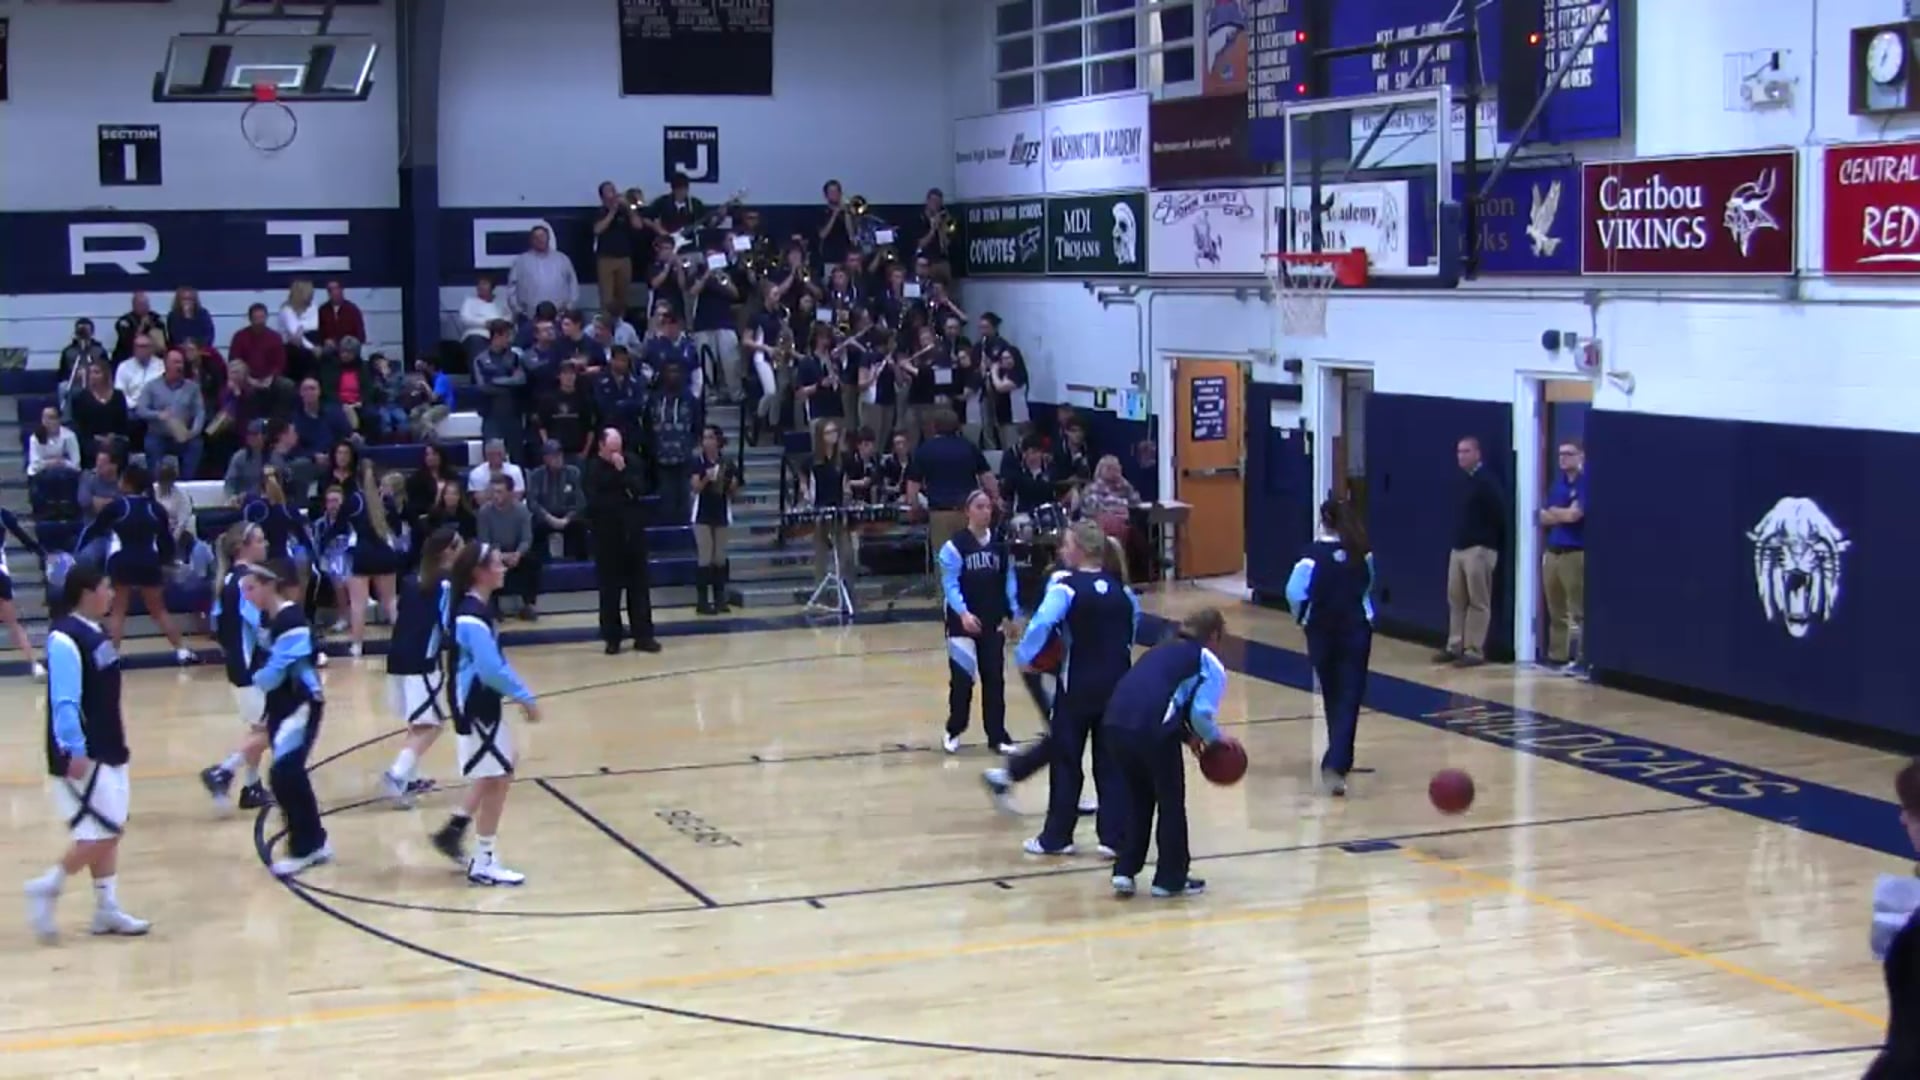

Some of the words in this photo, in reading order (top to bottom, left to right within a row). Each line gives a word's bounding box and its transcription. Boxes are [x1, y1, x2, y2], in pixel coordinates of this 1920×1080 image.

[101, 129, 158, 140] SECTION
[667, 130, 717, 140] SECTION
[1051, 131, 1100, 163] WASHINGTON
[1103, 127, 1142, 158] ACADEMY
[675, 143, 709, 179] J
[1838, 155, 1919, 185] CENTRAL
[1600, 174, 1703, 212] Caribou
[1063, 208, 1091, 234] MDI
[1596, 216, 1707, 250] VIKINGS
[1862, 206, 1919, 247] RED
[969, 238, 1017, 264] COYOTES
